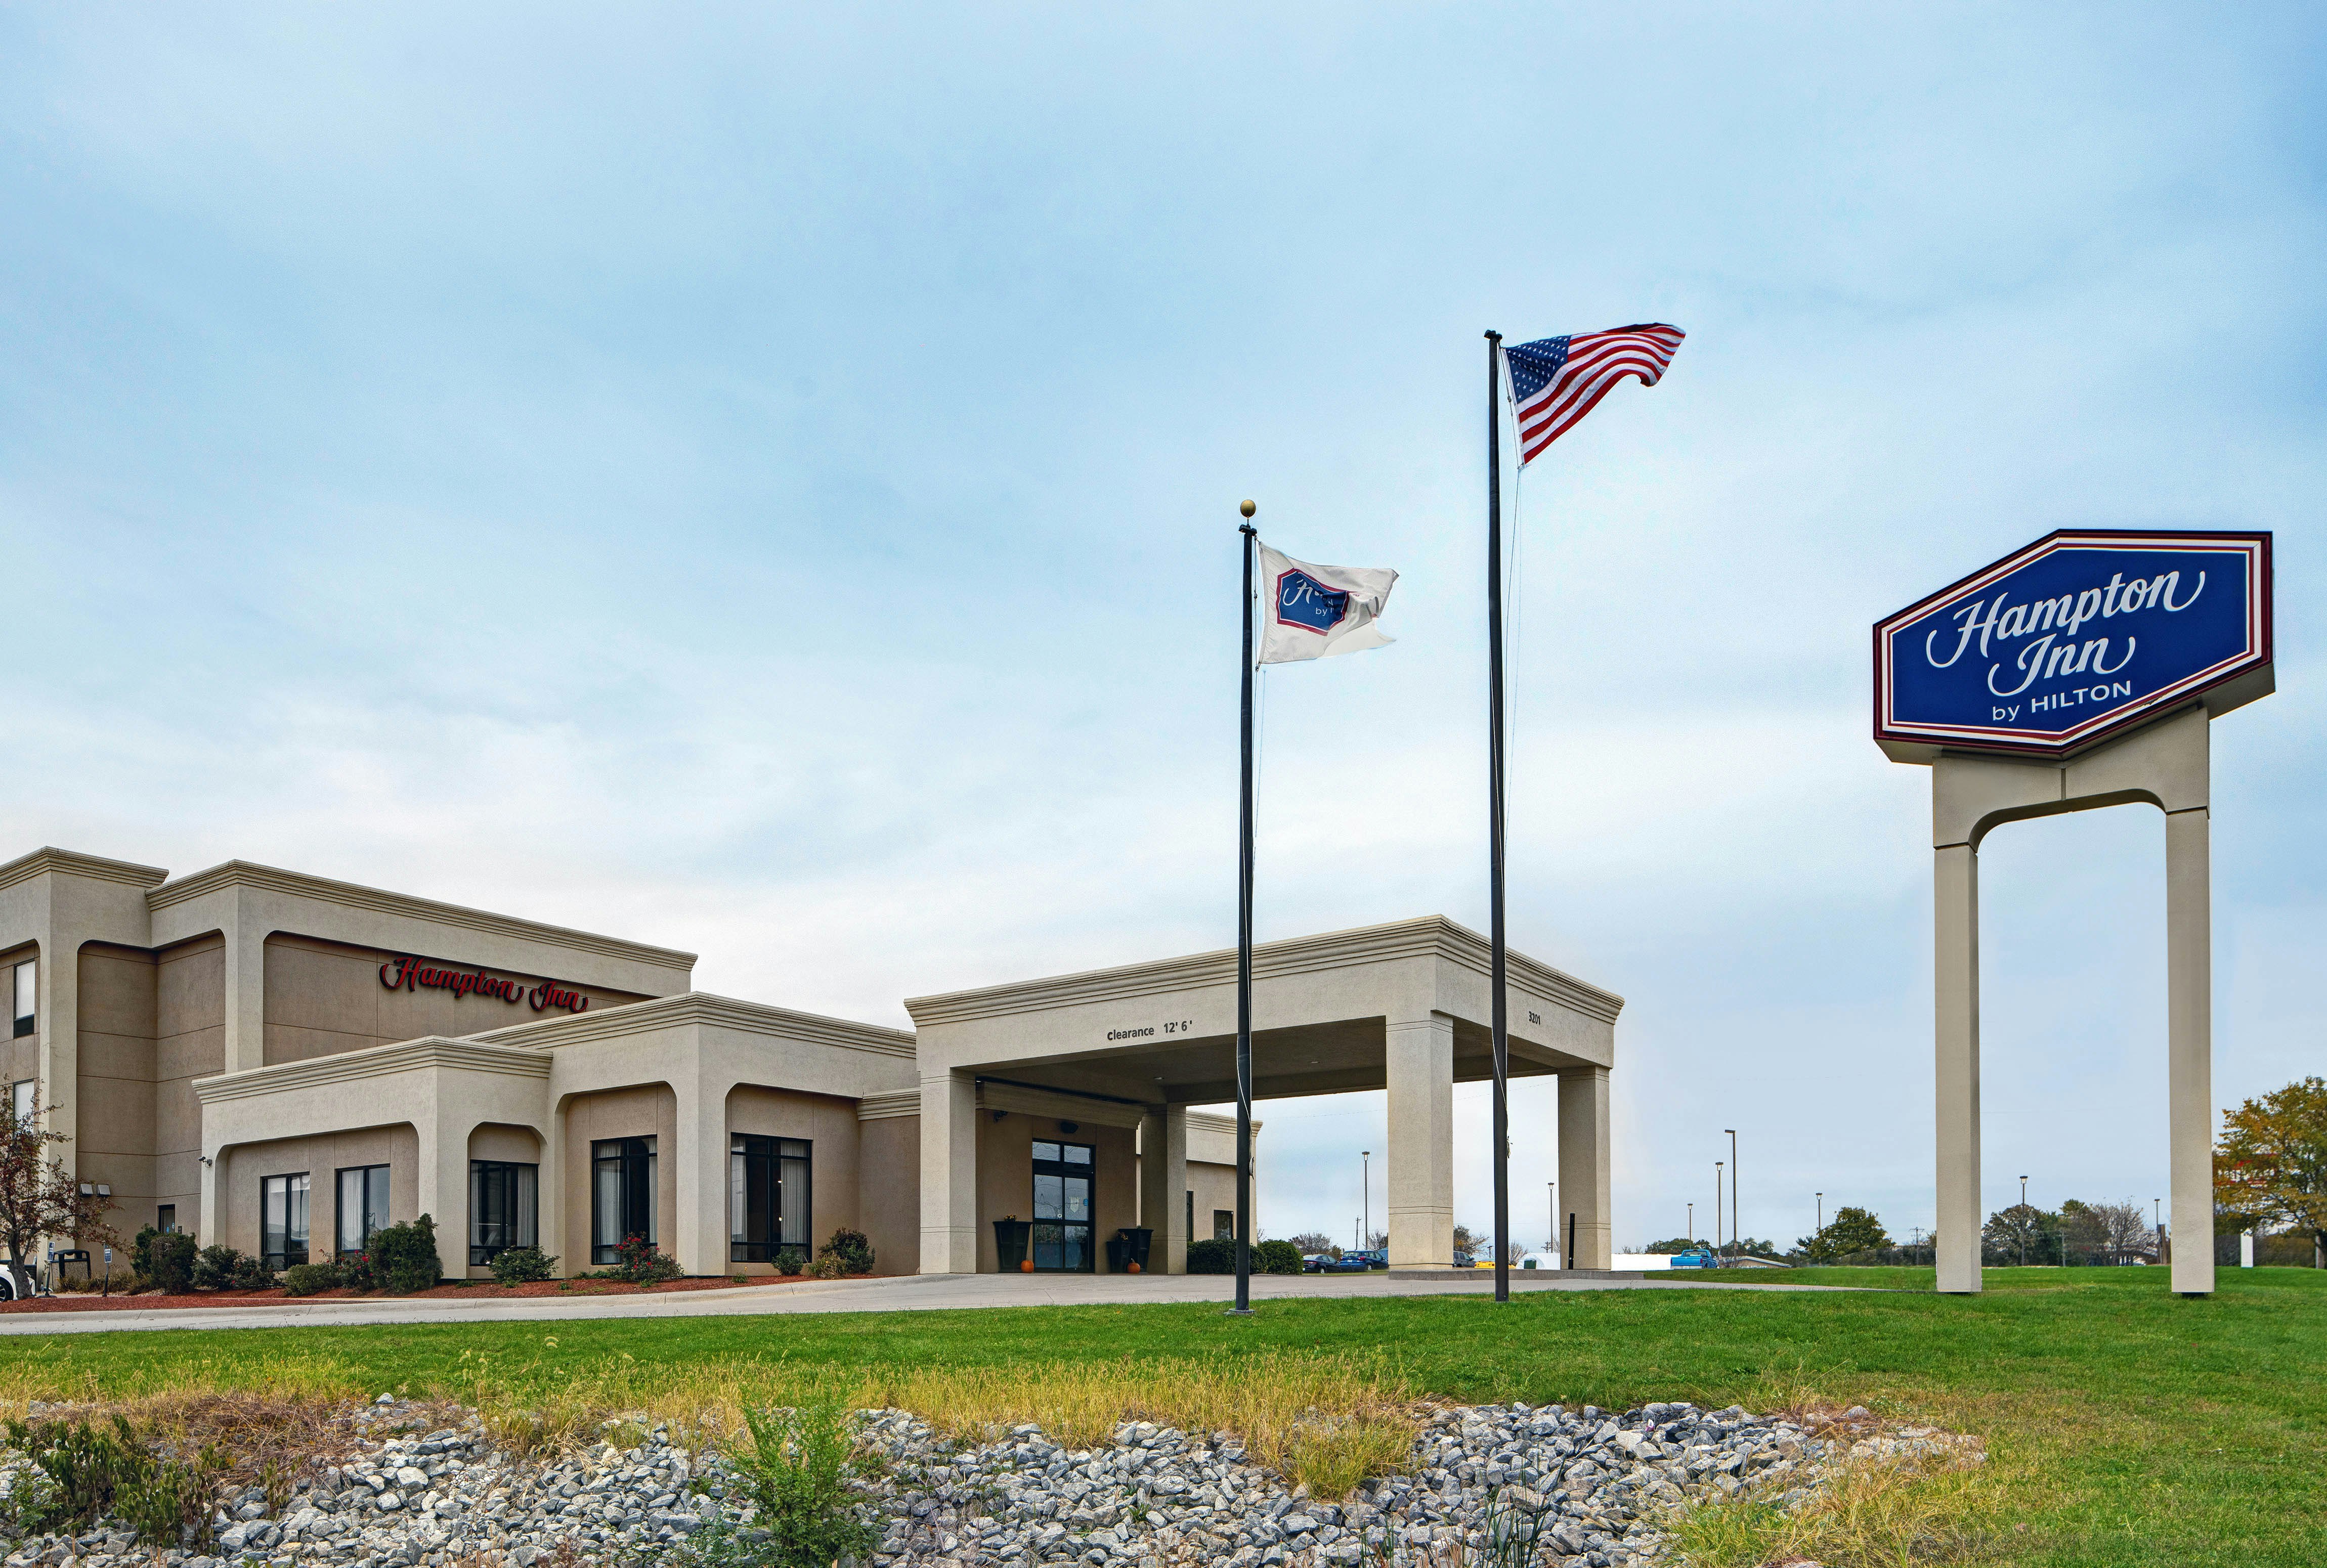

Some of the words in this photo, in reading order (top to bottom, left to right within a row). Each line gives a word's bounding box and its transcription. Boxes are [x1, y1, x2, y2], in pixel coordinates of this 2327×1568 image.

[1315, 607, 1327, 617] by
[1926, 571, 2205, 668] Hampton
[1988, 633, 2136, 696] Inn
[1992, 706, 2020, 722] by
[2032, 680, 2132, 713] HILTON
[379, 956, 525, 1003] Hampton
[529, 981, 589, 1012] Inn
[1107, 1027, 1154, 1040] clearance
[1164, 1022, 1178, 1033] 12'
[1529, 1011, 1541, 1025] 3201
